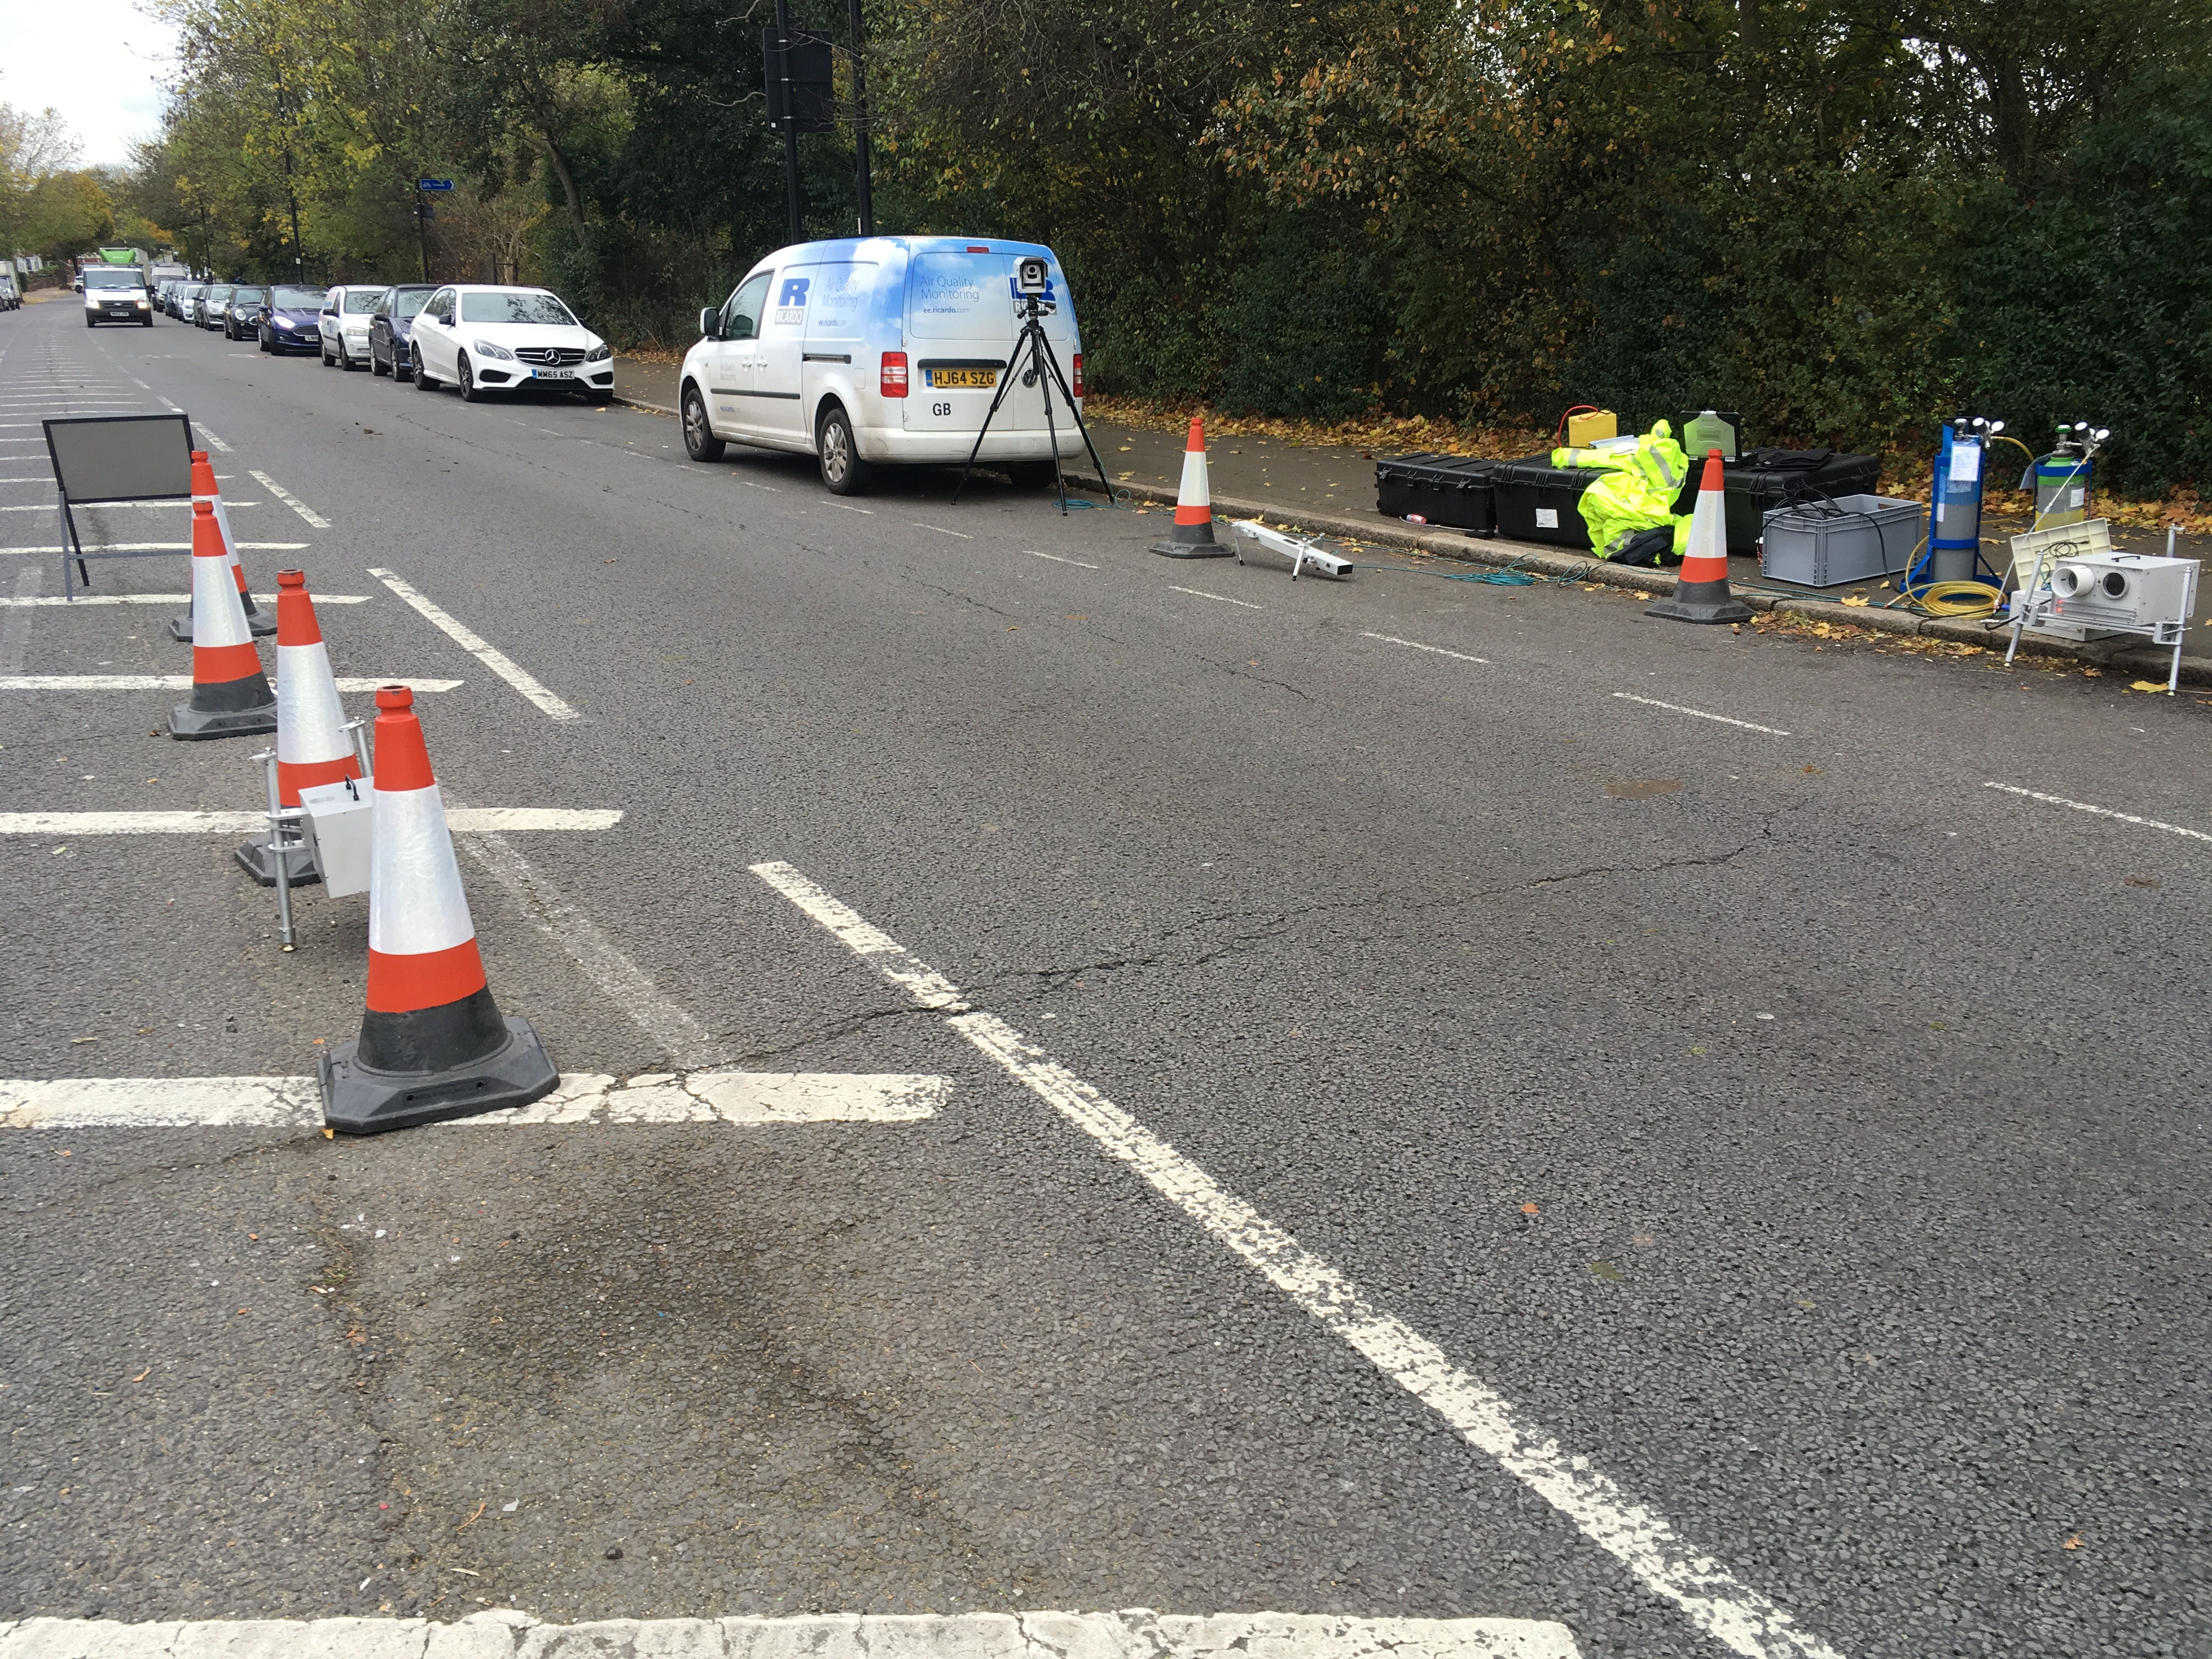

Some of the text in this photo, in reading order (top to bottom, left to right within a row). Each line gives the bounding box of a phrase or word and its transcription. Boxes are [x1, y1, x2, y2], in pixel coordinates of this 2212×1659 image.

[825, 278, 860, 292] Air Quality
[921, 276, 974, 290] Air Quality
[778, 278, 810, 306] R
[922, 289, 979, 302] Monitoring
[821, 294, 858, 311] Monitoring
[776, 310, 803, 323] RICARDO
[934, 372, 994, 385] HJ64 SZG
[933, 403, 951, 416] GB
